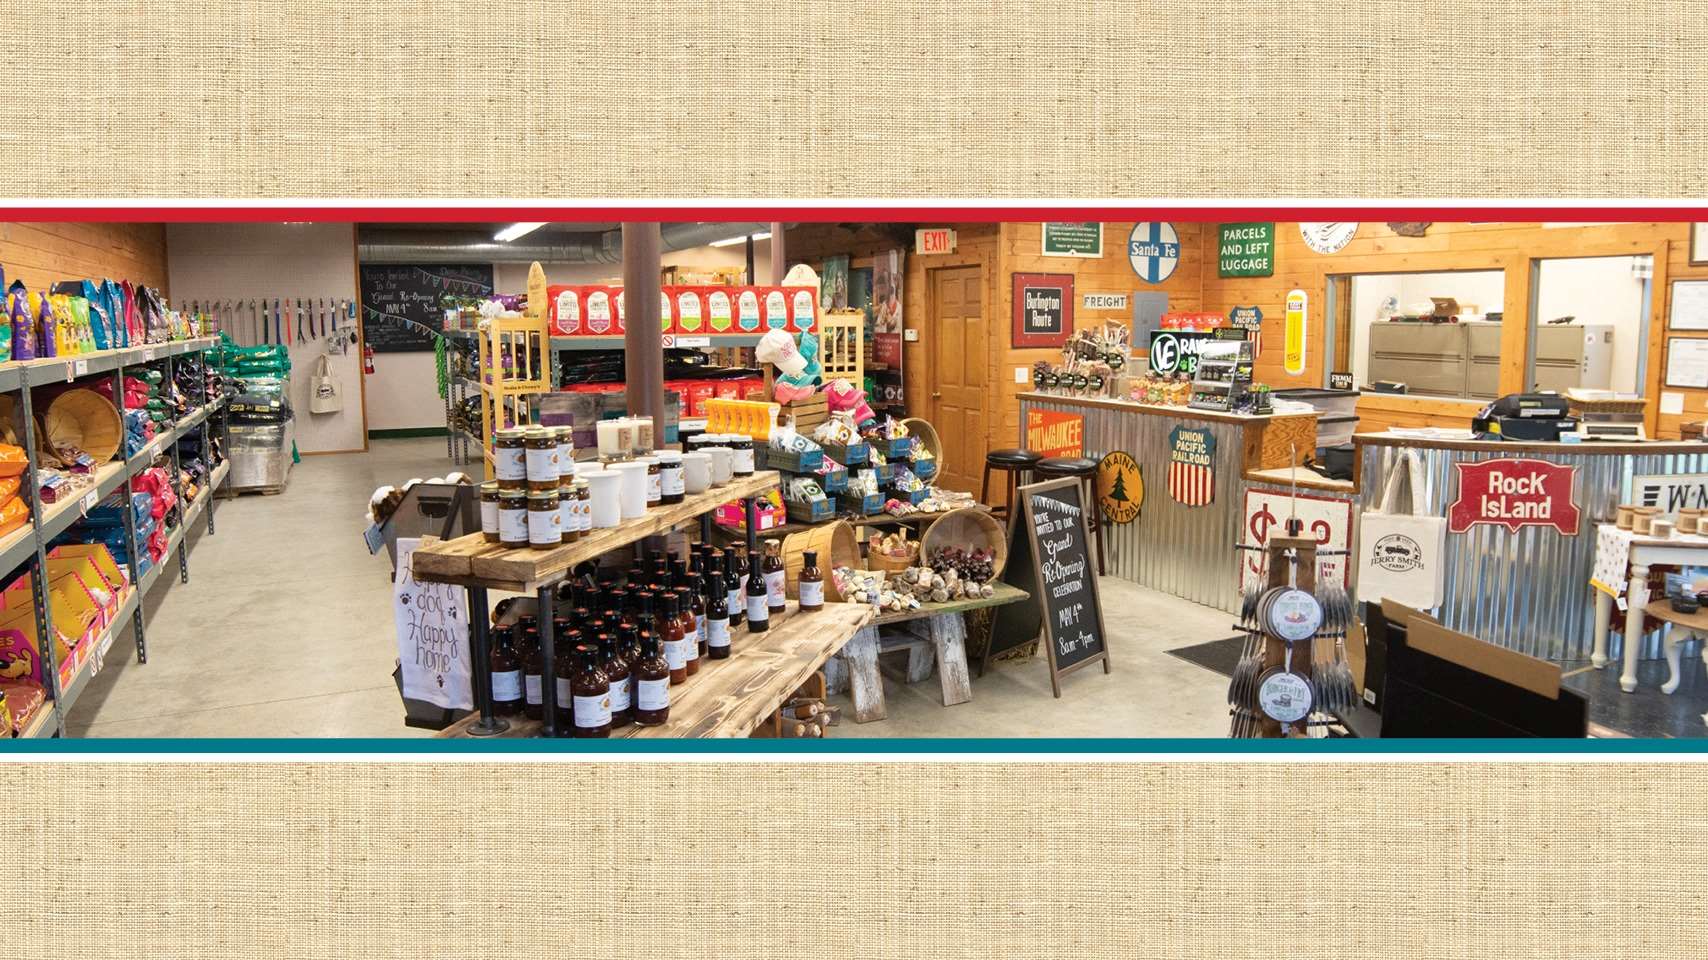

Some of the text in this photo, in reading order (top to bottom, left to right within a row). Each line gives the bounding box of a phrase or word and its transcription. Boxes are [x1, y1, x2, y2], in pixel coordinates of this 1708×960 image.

[924, 231, 948, 251] EXIT
[1224, 228, 1266, 241] PARCELS
[1131, 242, 1176, 258] Santa Fe
[1221, 242, 1269, 255] AND LEFT
[1318, 244, 1330, 254] THE
[1221, 256, 1268, 271] LUGGAGE
[1026, 291, 1060, 312] Burlington
[1084, 296, 1125, 307] FREIGHT
[1032, 310, 1052, 327] Route
[1029, 412, 1043, 426] THE
[1028, 418, 1082, 453] MILWAUKEE
[1178, 430, 1204, 443] UNION
[1176, 441, 1207, 454] PACIFIC
[1104, 453, 1136, 473] MAINE
[1172, 450, 1210, 466] RAILROAD
[1100, 496, 1140, 522] CENTRAL
[1036, 517, 1074, 536] INVITED TO OUR
[1043, 533, 1073, 564] Grand
[1370, 556, 1425, 570] JERRY SMITH
[1052, 579, 1083, 598] CELEBRATION
[417, 587, 445, 625] dog
[1059, 607, 1073, 628] MAY
[408, 609, 458, 659] Happy
[416, 635, 452, 673] home
